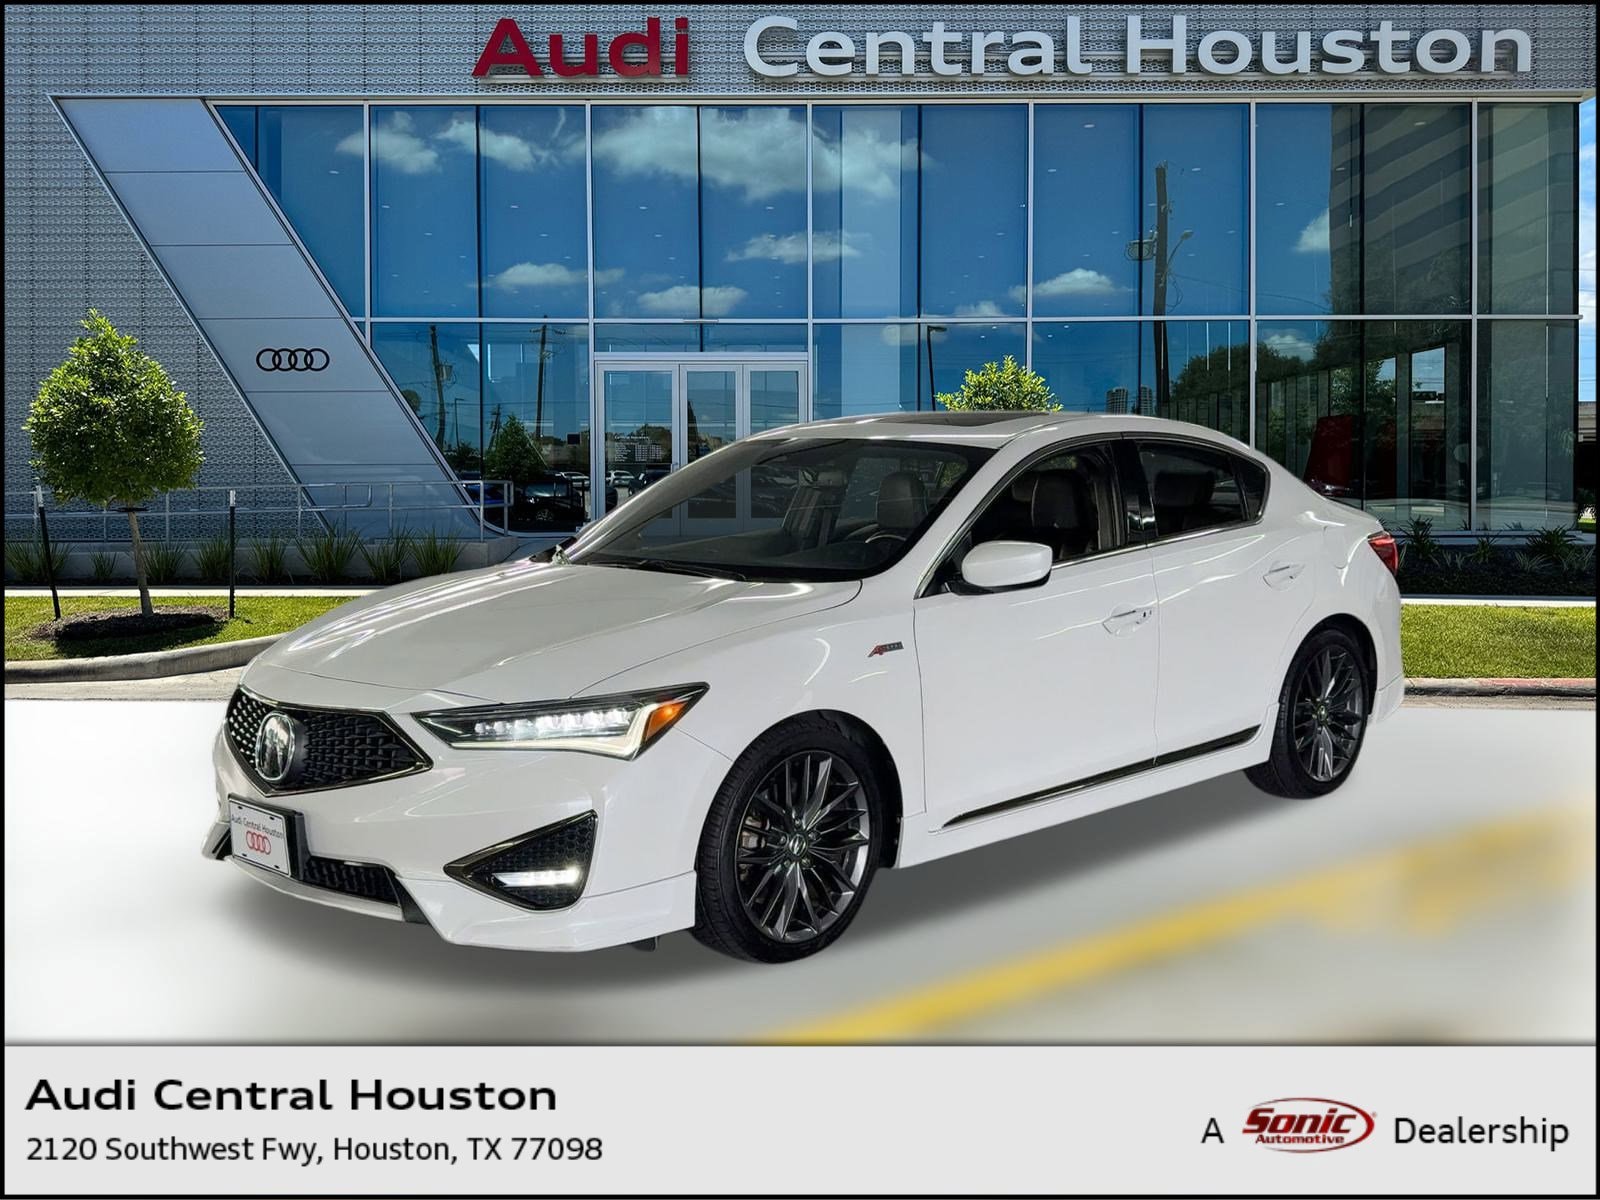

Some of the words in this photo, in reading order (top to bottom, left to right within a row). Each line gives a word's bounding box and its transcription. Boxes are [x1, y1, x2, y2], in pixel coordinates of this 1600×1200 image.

[472, 17, 689, 77] Audi
[743, 15, 1093, 77] Central
[1126, 15, 1532, 75] Houston
[231, 814, 243, 826] Audi
[243, 817, 262, 832] Central
[262, 823, 284, 839] Houston
